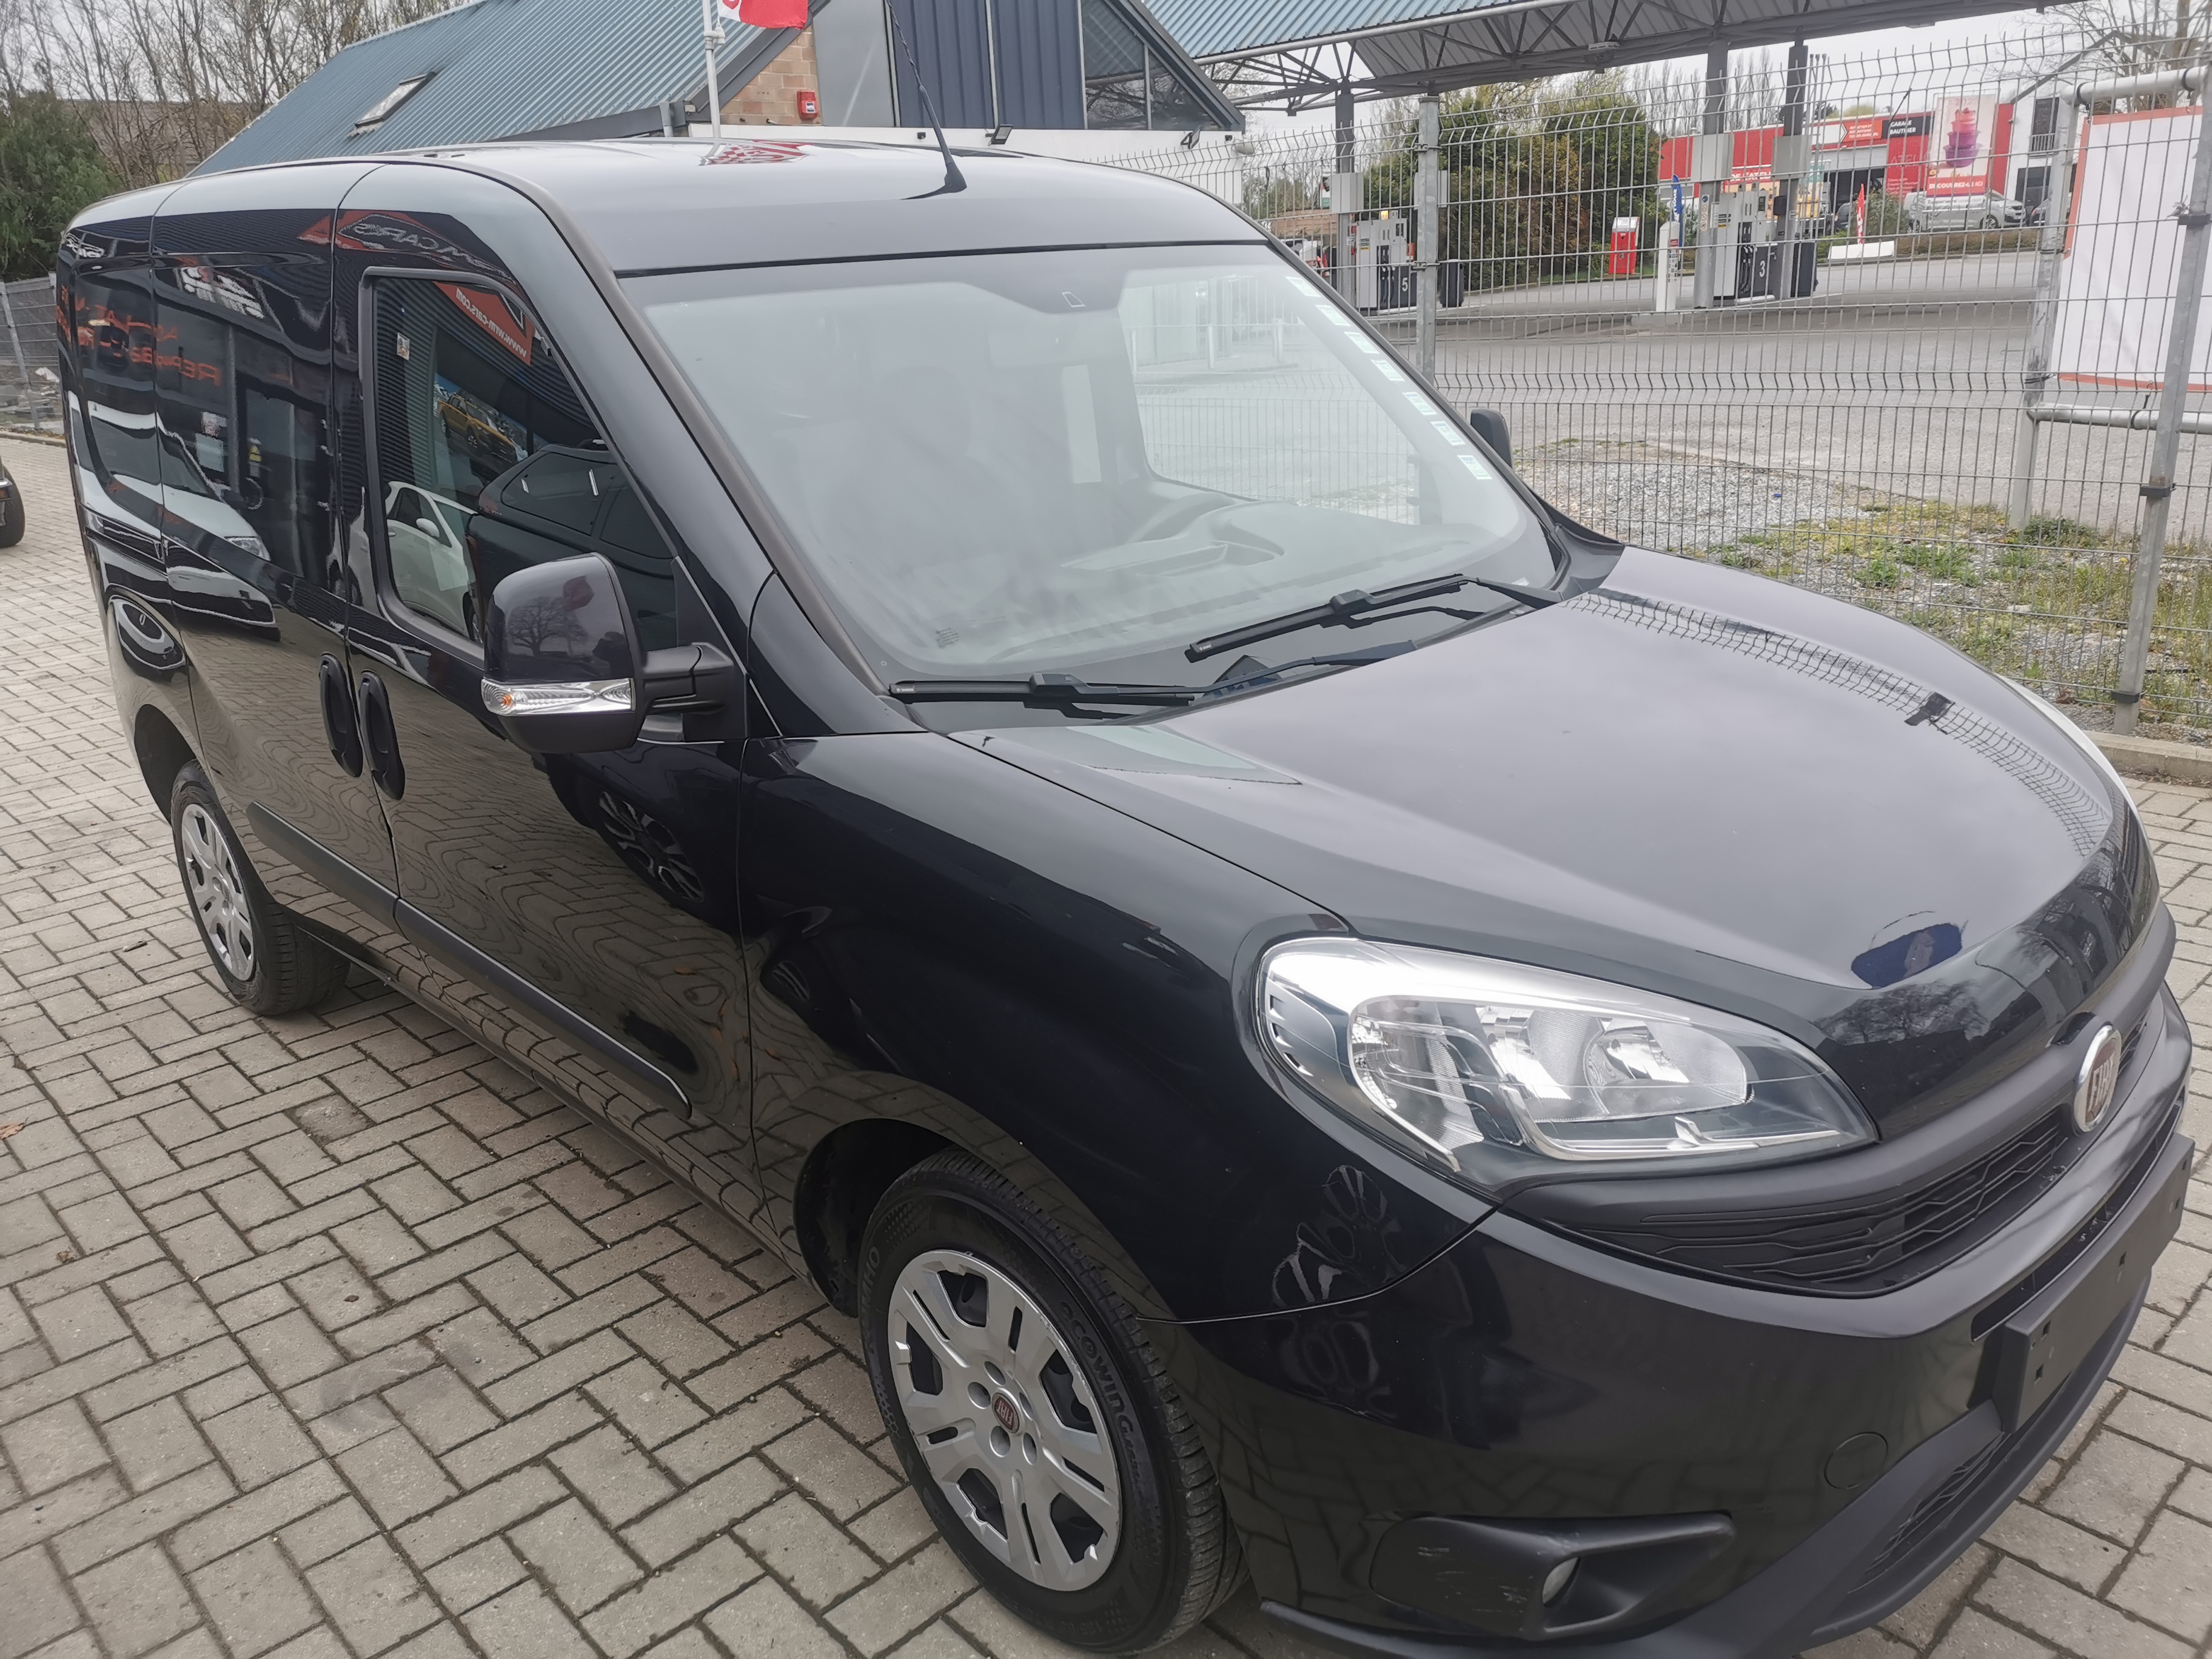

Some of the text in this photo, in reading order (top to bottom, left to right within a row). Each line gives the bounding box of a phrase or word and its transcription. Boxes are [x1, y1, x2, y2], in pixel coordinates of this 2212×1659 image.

[1759, 260, 1766, 278] 3
[1402, 277, 1408, 292] 5
[996, 1399, 1013, 1426] FIAT
